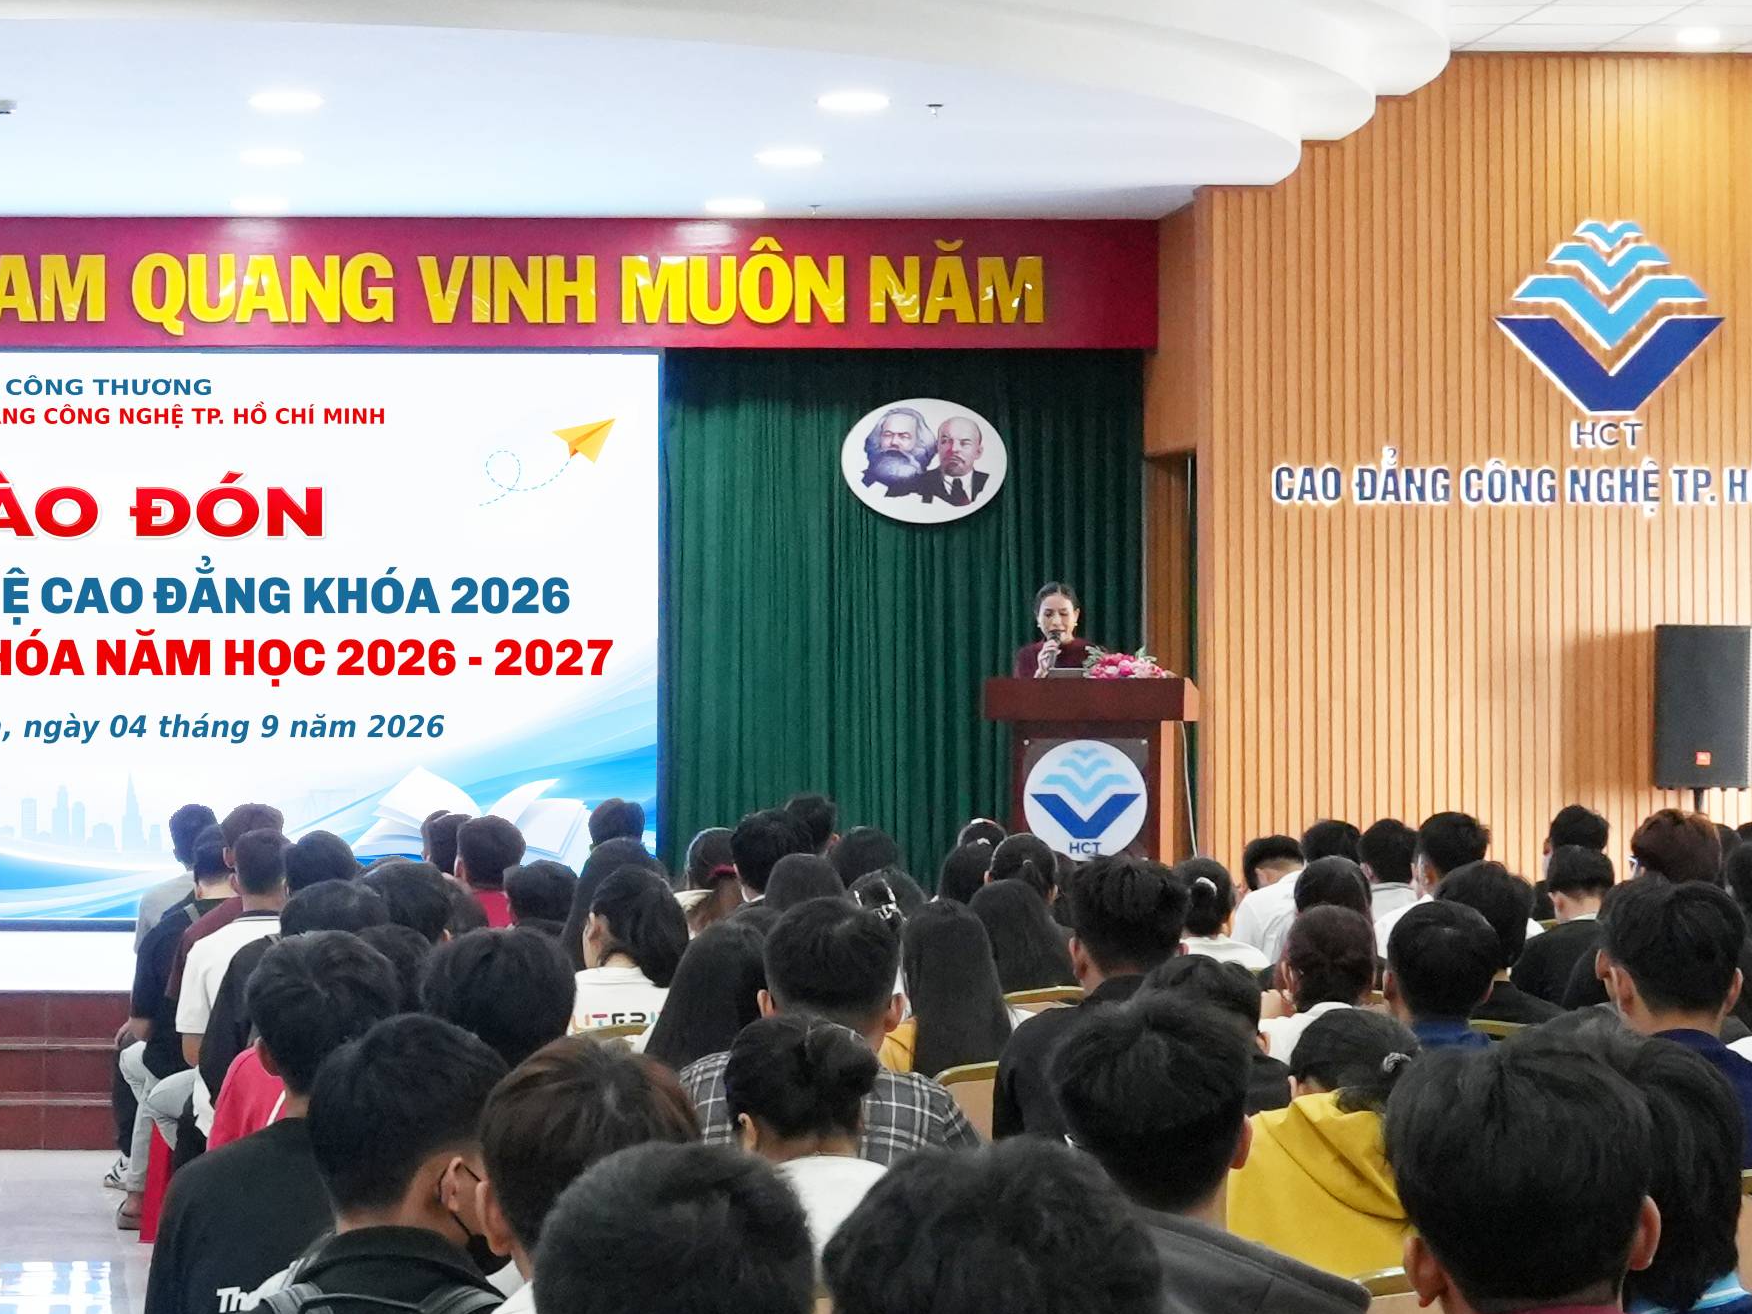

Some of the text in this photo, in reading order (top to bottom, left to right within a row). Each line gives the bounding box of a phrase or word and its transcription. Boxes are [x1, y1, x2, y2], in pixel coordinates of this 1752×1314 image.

[132, 253, 395, 336] QUANG
[420, 255, 597, 325] VINH
[620, 236, 846, 325] MUÔN
[869, 239, 1044, 325] NĂM
[5, 375, 84, 396] CÔNG
[92, 377, 212, 396] THƯƠNG
[43, 402, 110, 425] CÔNG
[119, 402, 184, 429] NGHỆ
[191, 407, 224, 425] TP.
[233, 400, 267, 425] HỒ
[275, 402, 314, 425] CHÍ
[323, 407, 385, 425] MINH
[1575, 422, 1642, 446] HCT
[1275, 466, 1342, 502] CAO
[1355, 447, 1451, 503] ĐẲNG
[1465, 460, 1556, 503] CÔNG
[1569, 460, 1661, 513] NGHỆ
[1672, 468, 1716, 503] TP.
[129, 471, 324, 538] ĐÓN
[41, 577, 143, 614] CAO
[153, 555, 291, 614] ĐẲNG
[303, 566, 440, 614] KHÓA
[451, 576, 570, 614] 2026
[96, 628, 211, 676] NĂM
[224, 638, 325, 688] HỌC
[336, 638, 456, 676] 2026
[468, 656, 482, 666] -
[494, 638, 613, 676] 2027
[23, 712, 101, 744] ngày
[109, 714, 147, 738] 04
[159, 712, 250, 744] tháng
[261, 714, 279, 738] 9
[289, 713, 356, 738] năm
[367, 714, 445, 738] 2026
[1069, 842, 1102, 854] HCT
